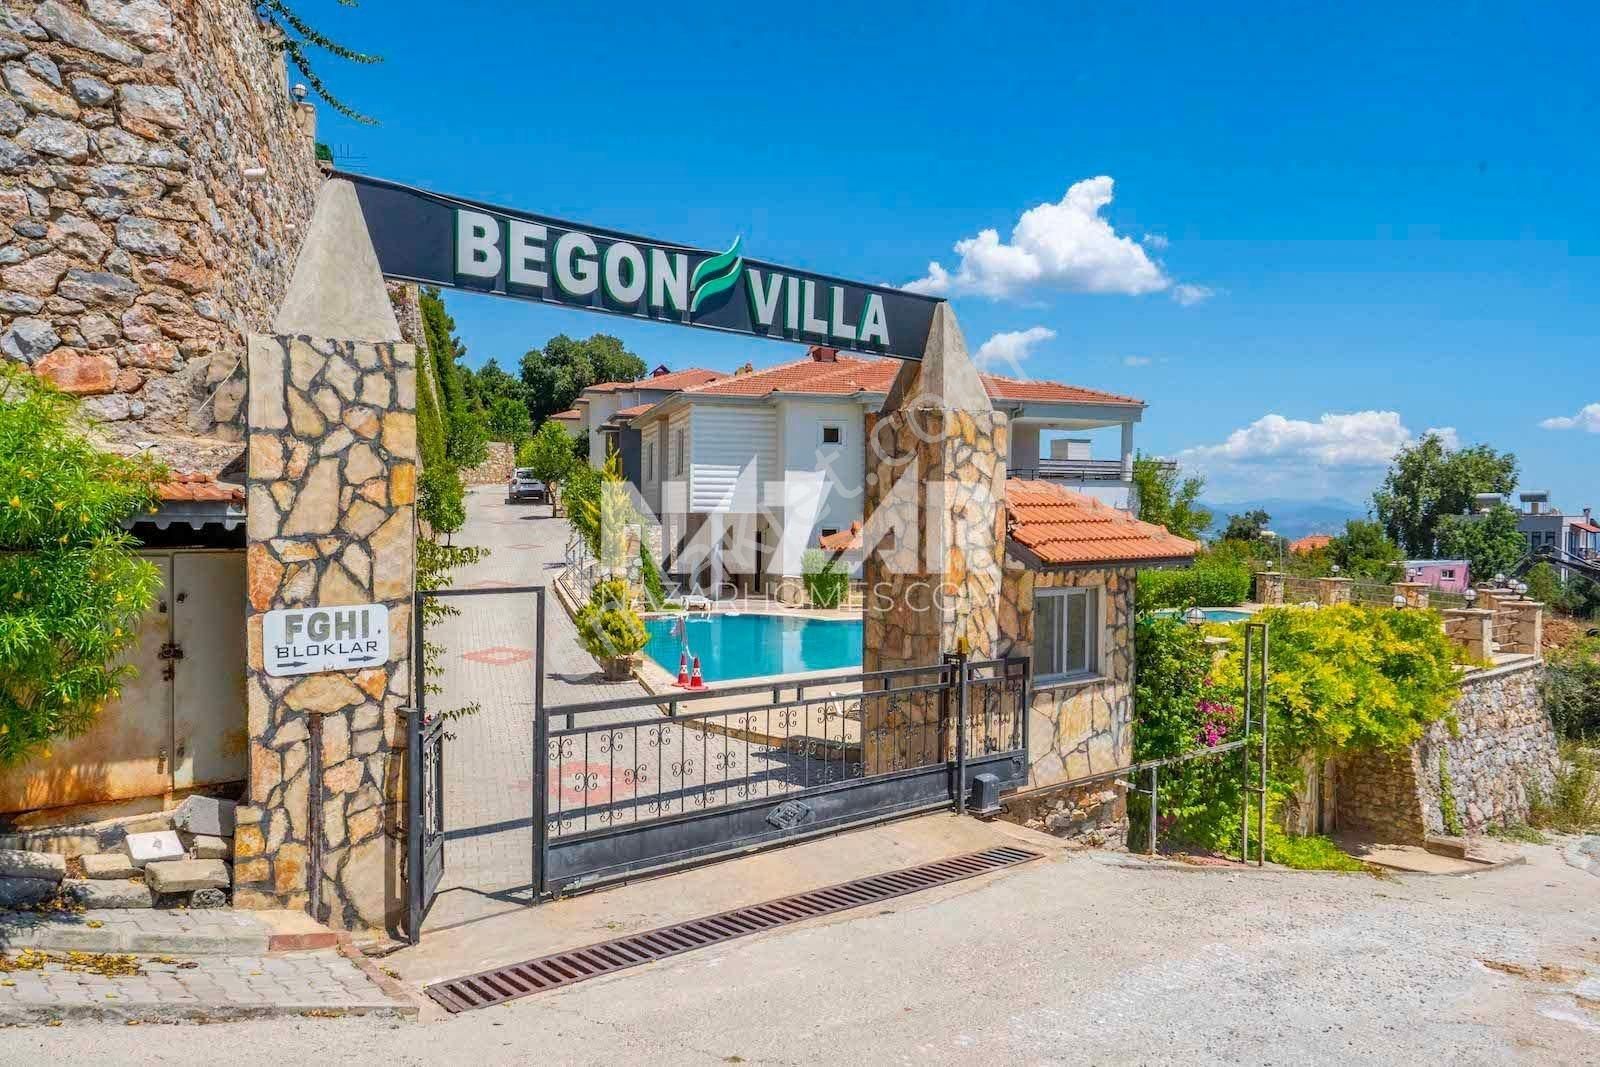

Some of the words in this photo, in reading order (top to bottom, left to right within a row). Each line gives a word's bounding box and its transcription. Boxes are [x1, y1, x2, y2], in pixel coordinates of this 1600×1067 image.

[746, 267, 890, 346] VILLA
[286, 609, 370, 644] FGHI
[276, 641, 378, 659] BLOKLAR
